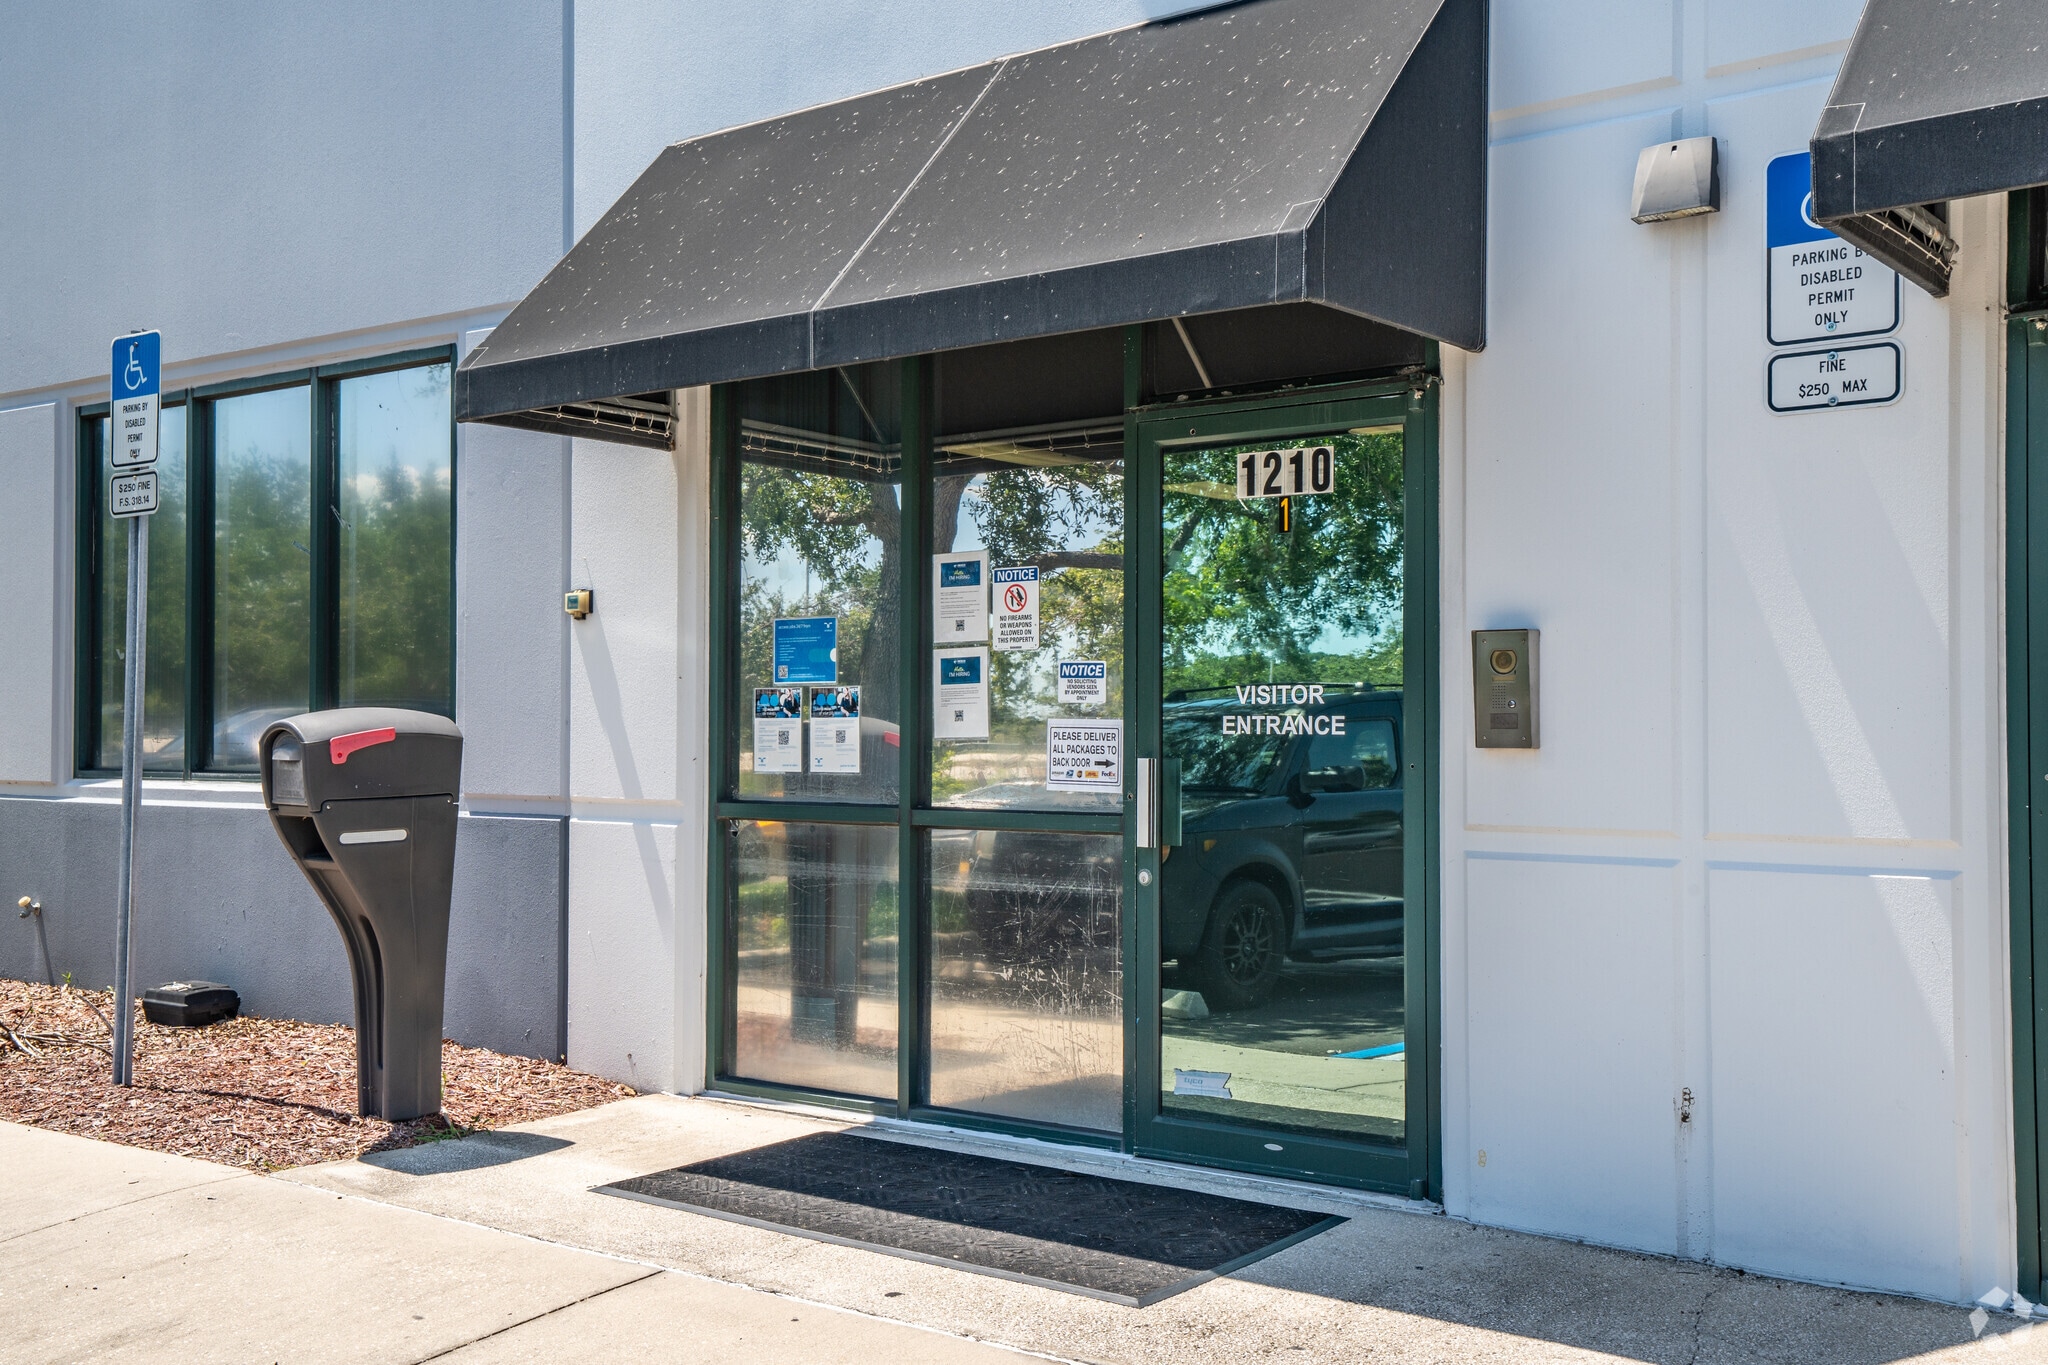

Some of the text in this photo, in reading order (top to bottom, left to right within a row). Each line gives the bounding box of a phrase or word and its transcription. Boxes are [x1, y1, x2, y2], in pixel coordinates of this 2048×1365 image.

[1792, 248, 1847, 267] PARKING
[1801, 266, 1862, 286] DISABLED
[1808, 288, 1855, 306] PERMIT
[1814, 310, 1848, 326] ONLY
[1819, 358, 1846, 374] FINE
[1798, 379, 1867, 398] $250 MAX
[123, 402, 148, 414] PARKING BY
[125, 417, 146, 428] DISABLED
[127, 432, 143, 443] PERMIT
[129, 448, 141, 458] ONLY
[1241, 448, 1330, 497] 1210
[119, 480, 151, 493] $250 FINE
[119, 494, 150, 507] F.S. 318.14
[1280, 497, 1289, 532] 1
[997, 568, 1035, 582] NOTICE
[1008, 614, 1032, 622] FIREARMS
[1000, 621, 1032, 629] OR WEAPONS
[1024, 628, 1032, 636] ON
[1062, 664, 1103, 676] NOTICE
[1235, 685, 1325, 705] VISITOR
[1222, 715, 1345, 736] ENTRANCE
[1053, 731, 1116, 742] PLEASE DELIVER
[1053, 744, 1117, 755] ALL PACKAGES TO
[1053, 757, 1091, 767] BACK DOOR
